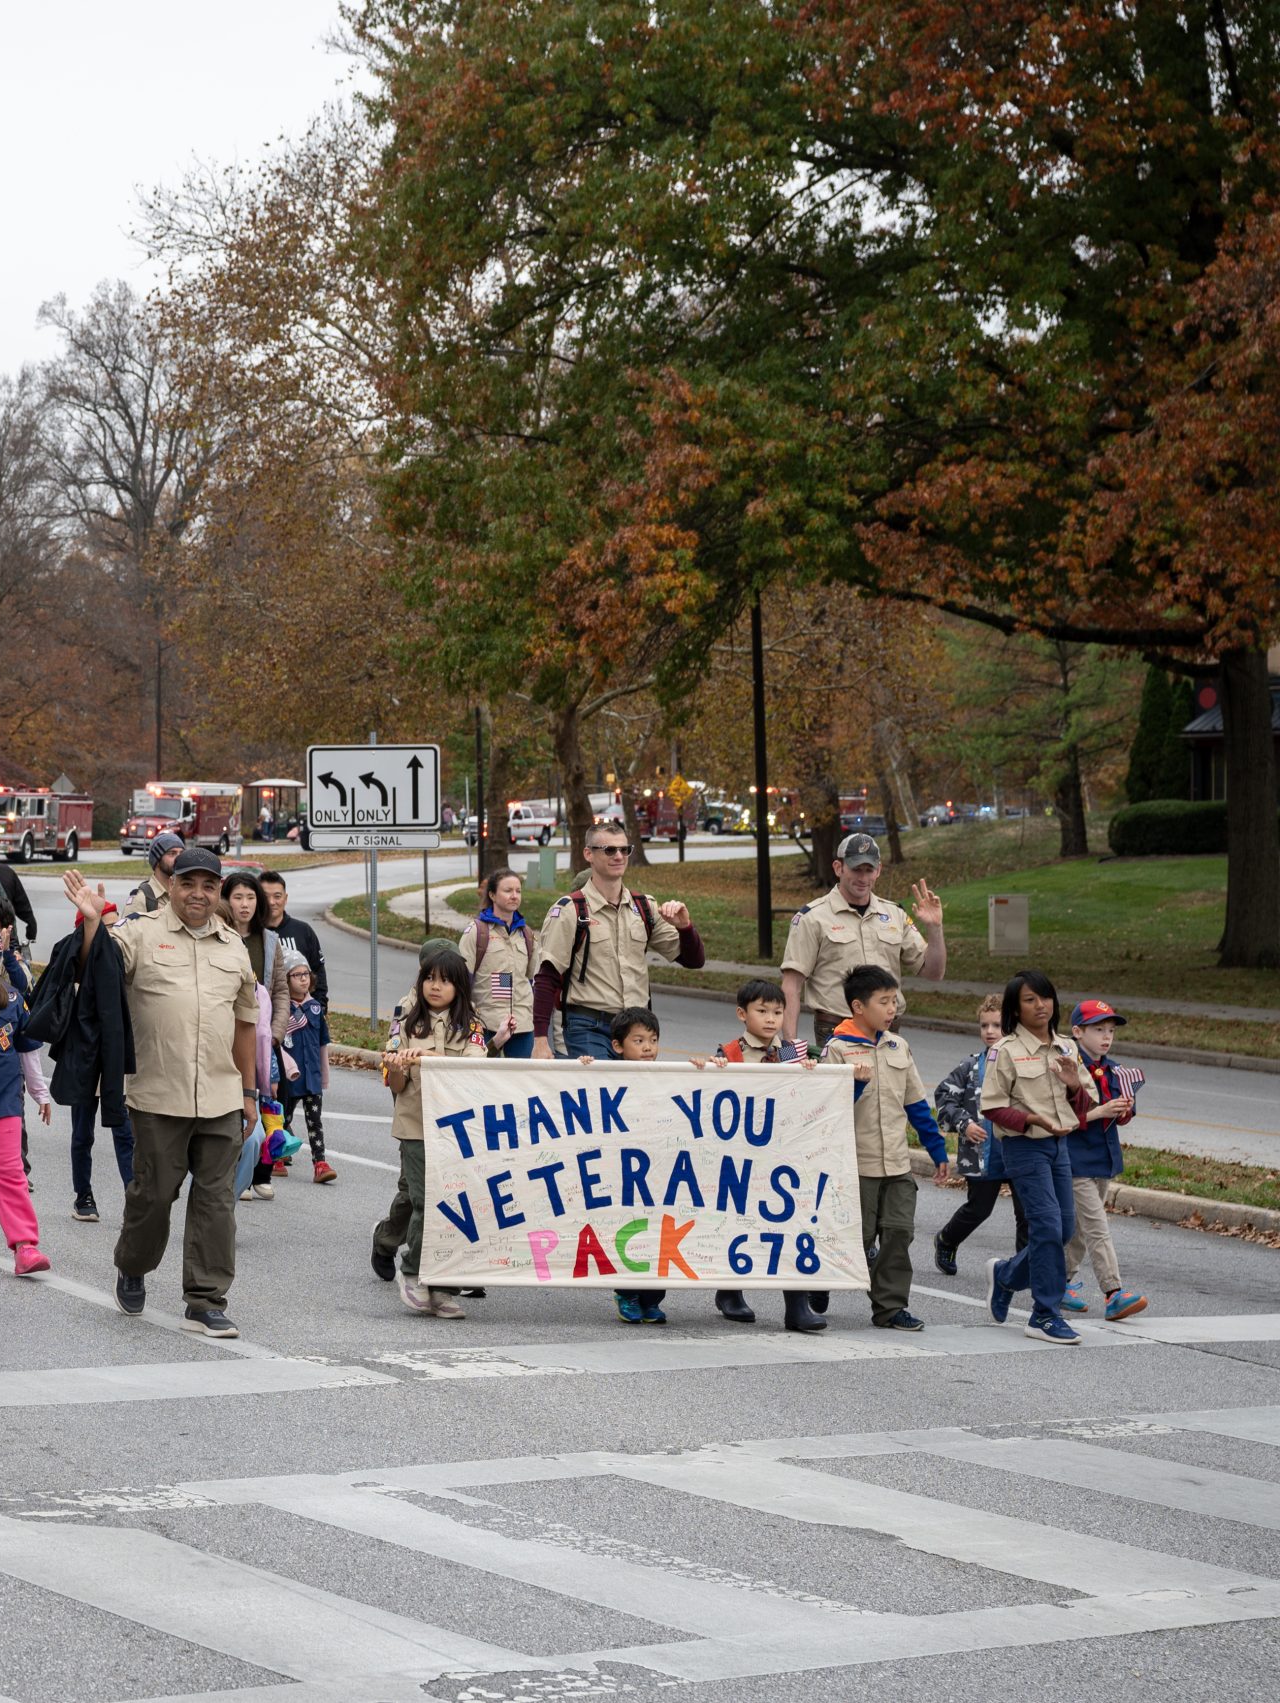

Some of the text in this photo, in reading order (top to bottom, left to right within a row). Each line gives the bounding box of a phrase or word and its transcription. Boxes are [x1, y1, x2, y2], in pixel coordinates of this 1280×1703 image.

[315, 809, 391, 822] ONLY ONLY
[347, 836, 402, 846] AT SIGNAL
[435, 1086, 775, 1159] THANK YOU
[436, 1148, 829, 1243] VETERANS!
[527, 1213, 821, 1282] PACK 678
